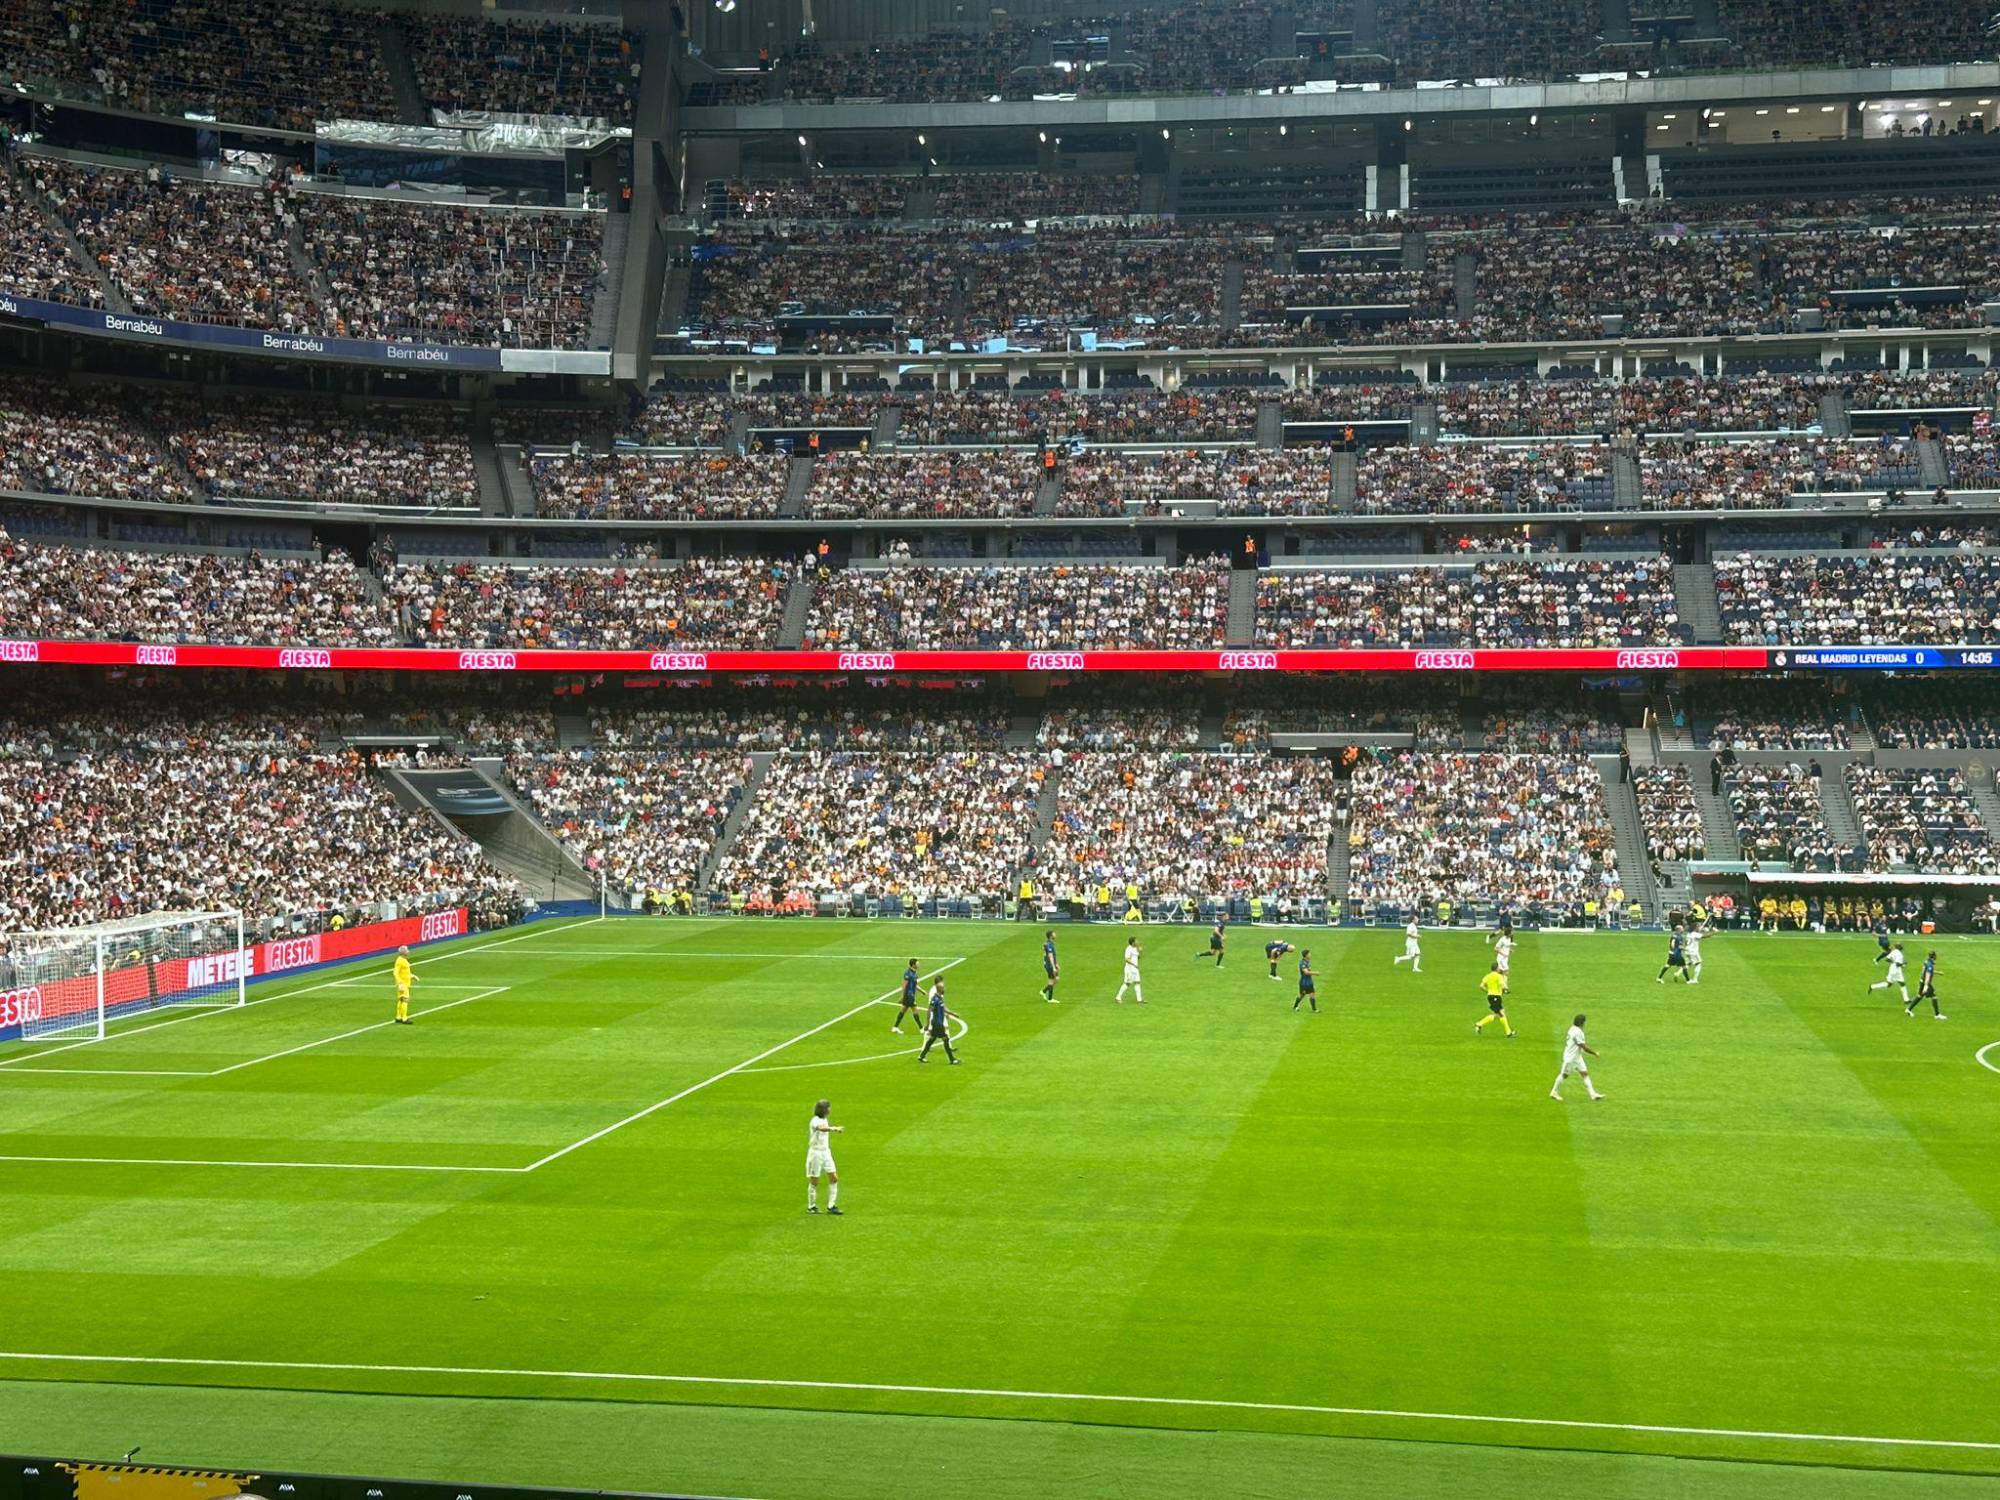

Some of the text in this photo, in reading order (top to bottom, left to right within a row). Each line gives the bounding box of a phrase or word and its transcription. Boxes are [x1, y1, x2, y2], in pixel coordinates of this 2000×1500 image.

[105, 315, 163, 335] Bernabéu
[263, 334, 324, 352] Bernabéu
[387, 346, 449, 361] Bernabéu
[136, 645, 177, 665] FIESTA
[279, 650, 331, 668] FIESTA
[459, 652, 516, 670] FIESTA
[650, 653, 707, 670] FIESTA
[839, 654, 894, 670] FIESTA
[1027, 653, 1084, 670] FIESTA
[1219, 653, 1277, 670] FIESTA
[1415, 652, 1474, 668] FIESTA
[1617, 651, 1678, 668] FIESTA
[1795, 652, 1925, 664] REAL MADRID LEYENDAS 0
[1960, 652, 1993, 664] 14:05
[421, 909, 459, 941] FIESTA
[271, 937, 315, 971] FIESTA
